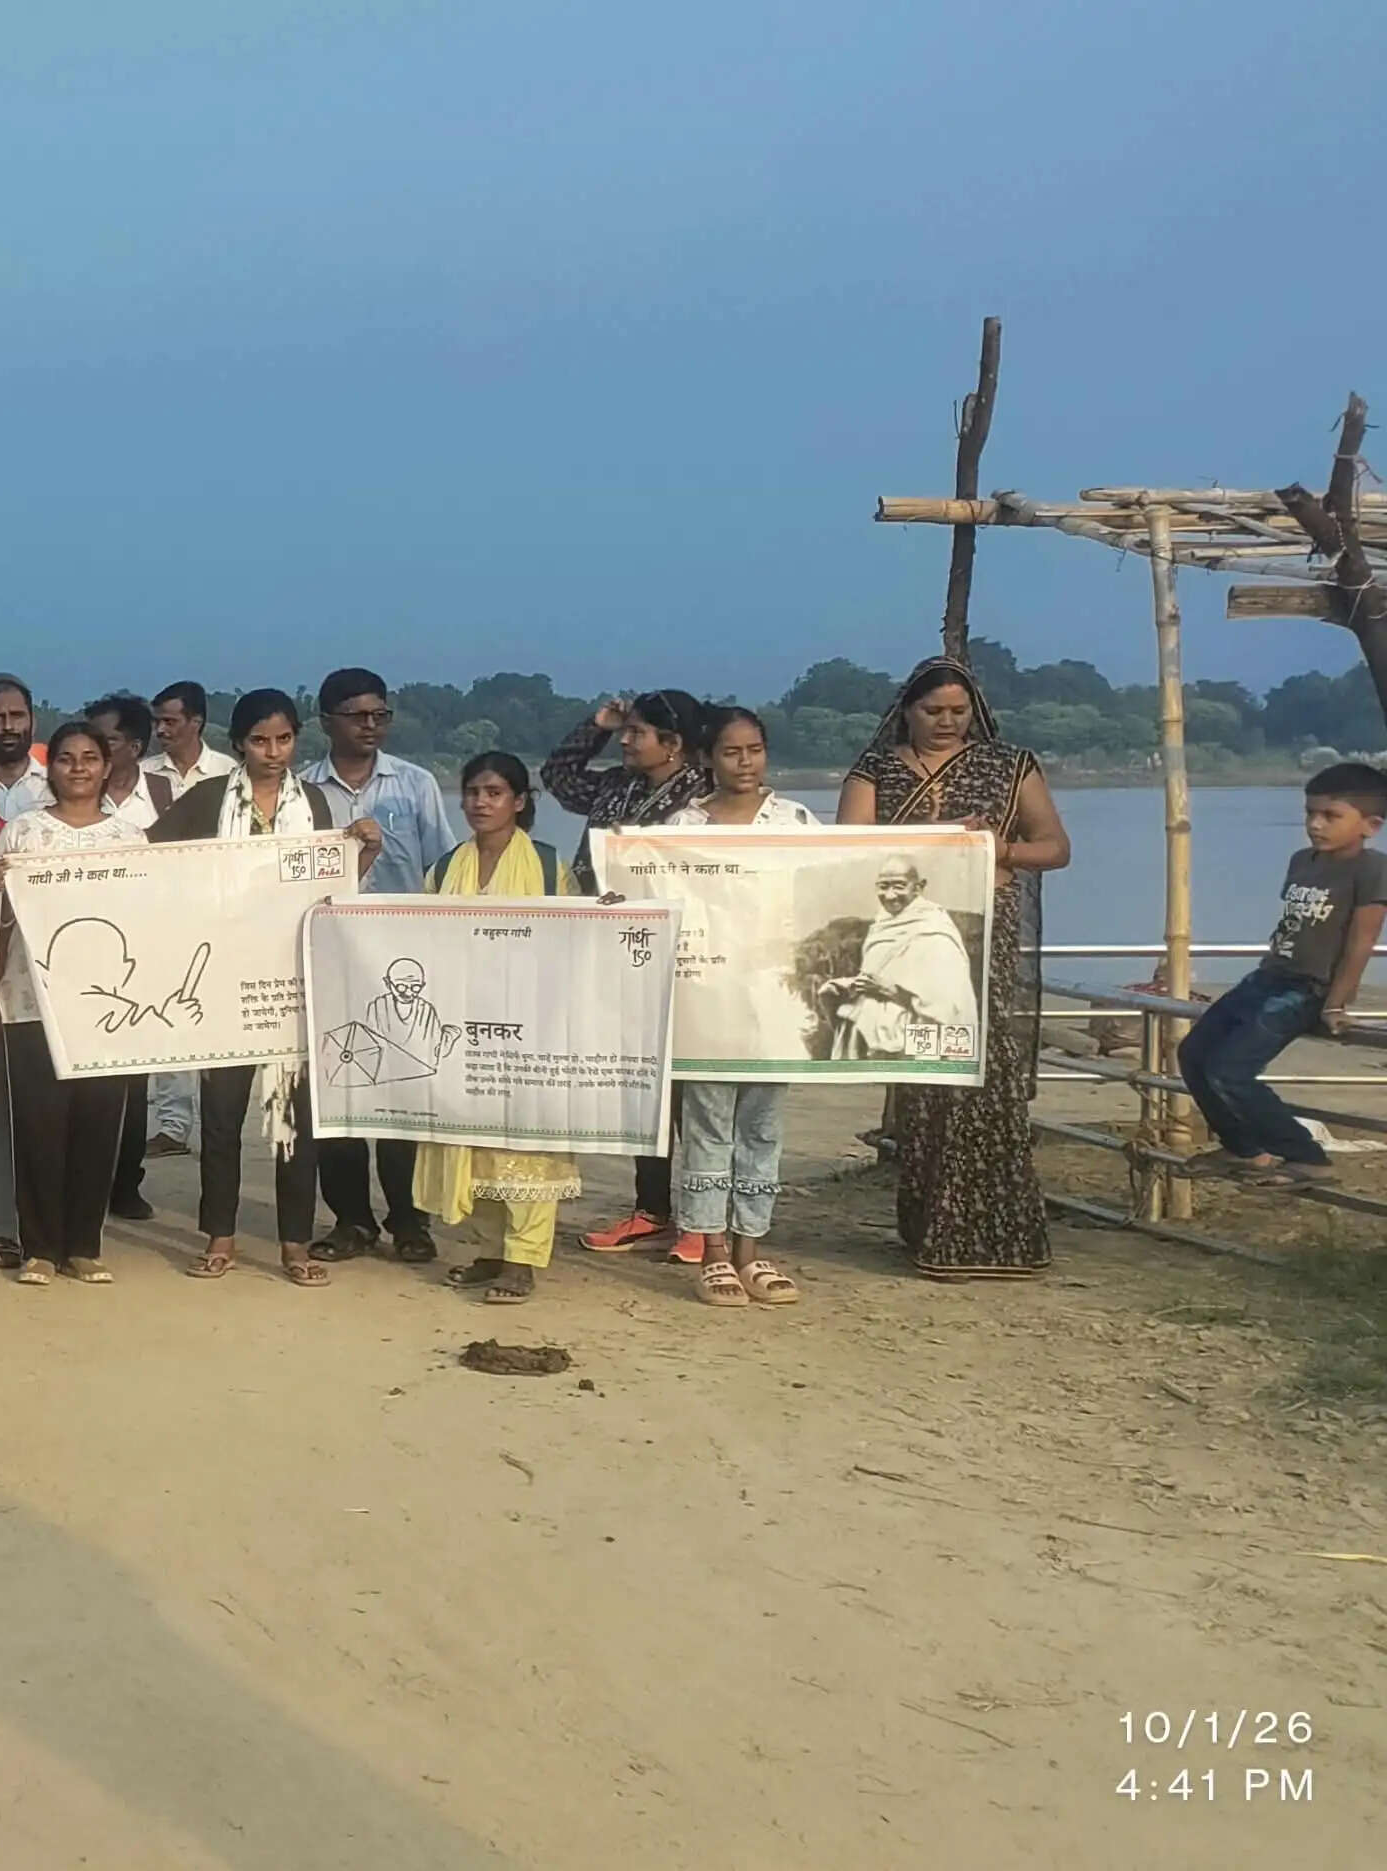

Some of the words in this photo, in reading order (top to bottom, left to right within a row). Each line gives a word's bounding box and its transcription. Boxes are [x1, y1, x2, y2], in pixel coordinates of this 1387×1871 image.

[283, 850, 309, 867] गांधी
[318, 867, 341, 877] Asha
[629, 860, 657, 876] गांधी
[681, 861, 690, 875] ने
[694, 864, 720, 876] कहा
[724, 864, 739, 874] था
[27, 872, 53, 886] गांधी
[56, 870, 70, 884] जी
[74, 868, 83, 883] ने
[87, 868, 108, 881] कहा
[482, 926, 508, 939] बहुरूप
[509, 926, 531, 938] गांधी
[619, 927, 657, 949] गांधी
[465, 1021, 523, 1046] बुनकर
